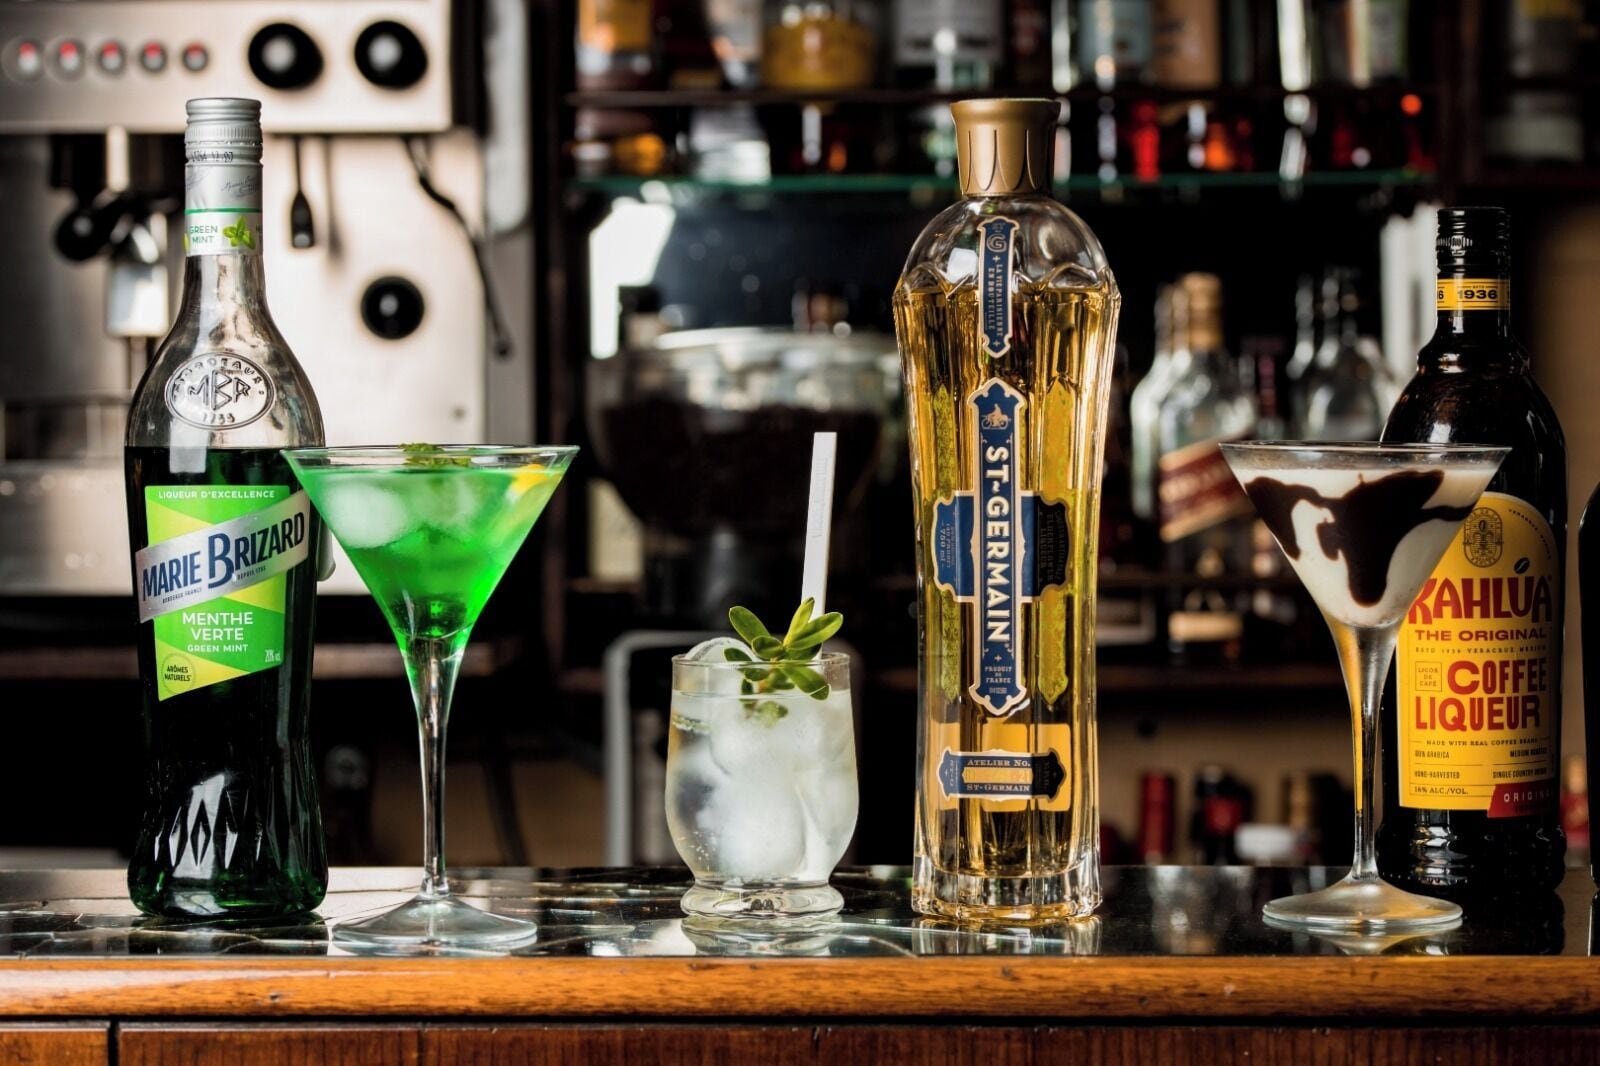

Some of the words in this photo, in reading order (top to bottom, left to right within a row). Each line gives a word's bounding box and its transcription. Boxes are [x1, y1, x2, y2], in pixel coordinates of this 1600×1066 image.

[189, 226, 218, 234] GREEN
[1457, 290, 1498, 300] 1936
[158, 490, 198, 499] LIQUEUR
[200, 490, 275, 499] D'EXCELLENCE
[142, 550, 202, 601] MARIE
[208, 512, 305, 590] BRIZARD
[182, 612, 253, 625] MENTHE
[192, 628, 244, 640] VERTE
[1414, 630, 1452, 641] THE
[1458, 629, 1547, 641] ORIGINAL
[187, 644, 219, 652] GREEN
[223, 644, 248, 652] MINT
[166, 664, 188, 673] ARÔMES
[1447, 657, 1546, 695] COFFEE
[1416, 695, 1540, 732] LIQUEUR
